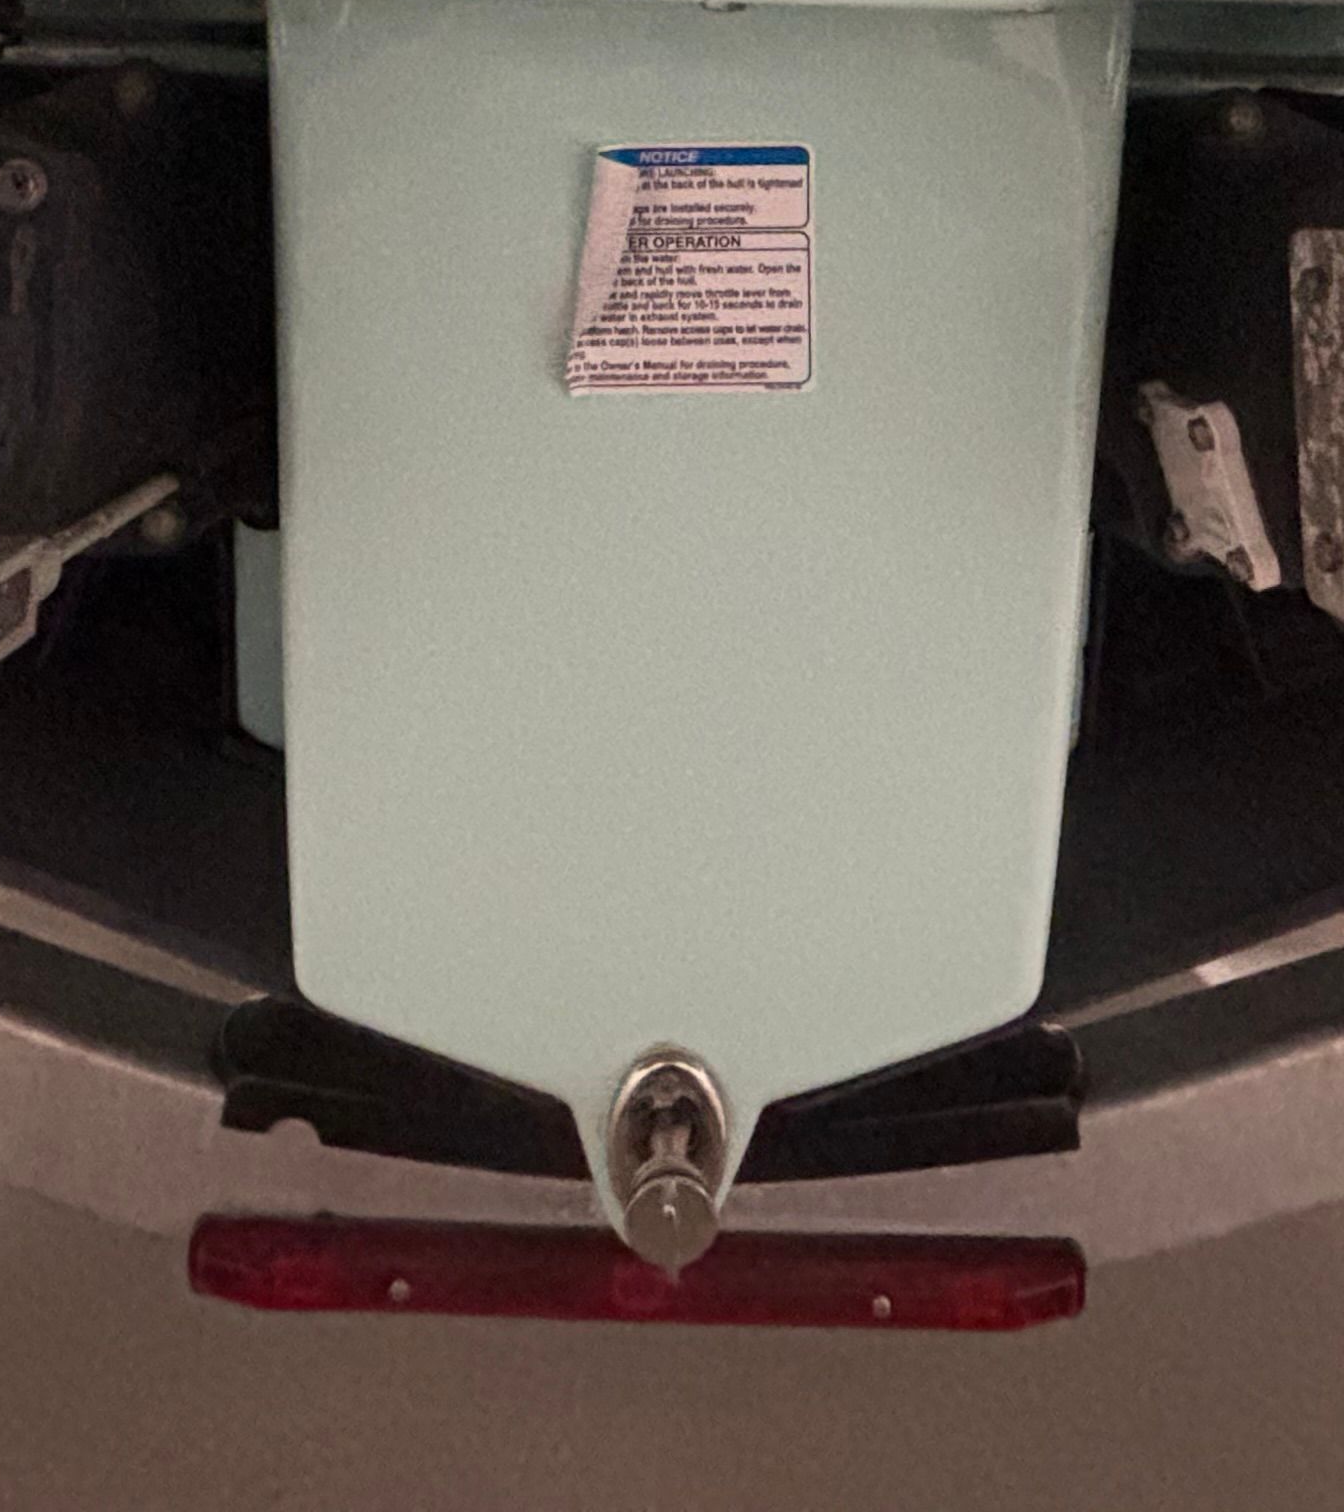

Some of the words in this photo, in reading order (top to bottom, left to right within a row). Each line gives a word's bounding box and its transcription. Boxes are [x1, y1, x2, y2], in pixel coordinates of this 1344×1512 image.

[640, 151, 699, 163] NOTICE
[653, 236, 741, 248] OPERATION
[758, 263, 783, 276] Open
[786, 264, 801, 273] the
[640, 290, 673, 302] rapidly
[768, 288, 791, 297] from
[777, 299, 803, 308] drain
[640, 312, 678, 321] exhaust
[600, 360, 641, 372] Owner's
[642, 360, 676, 371] Manual
[696, 359, 736, 371] draining
